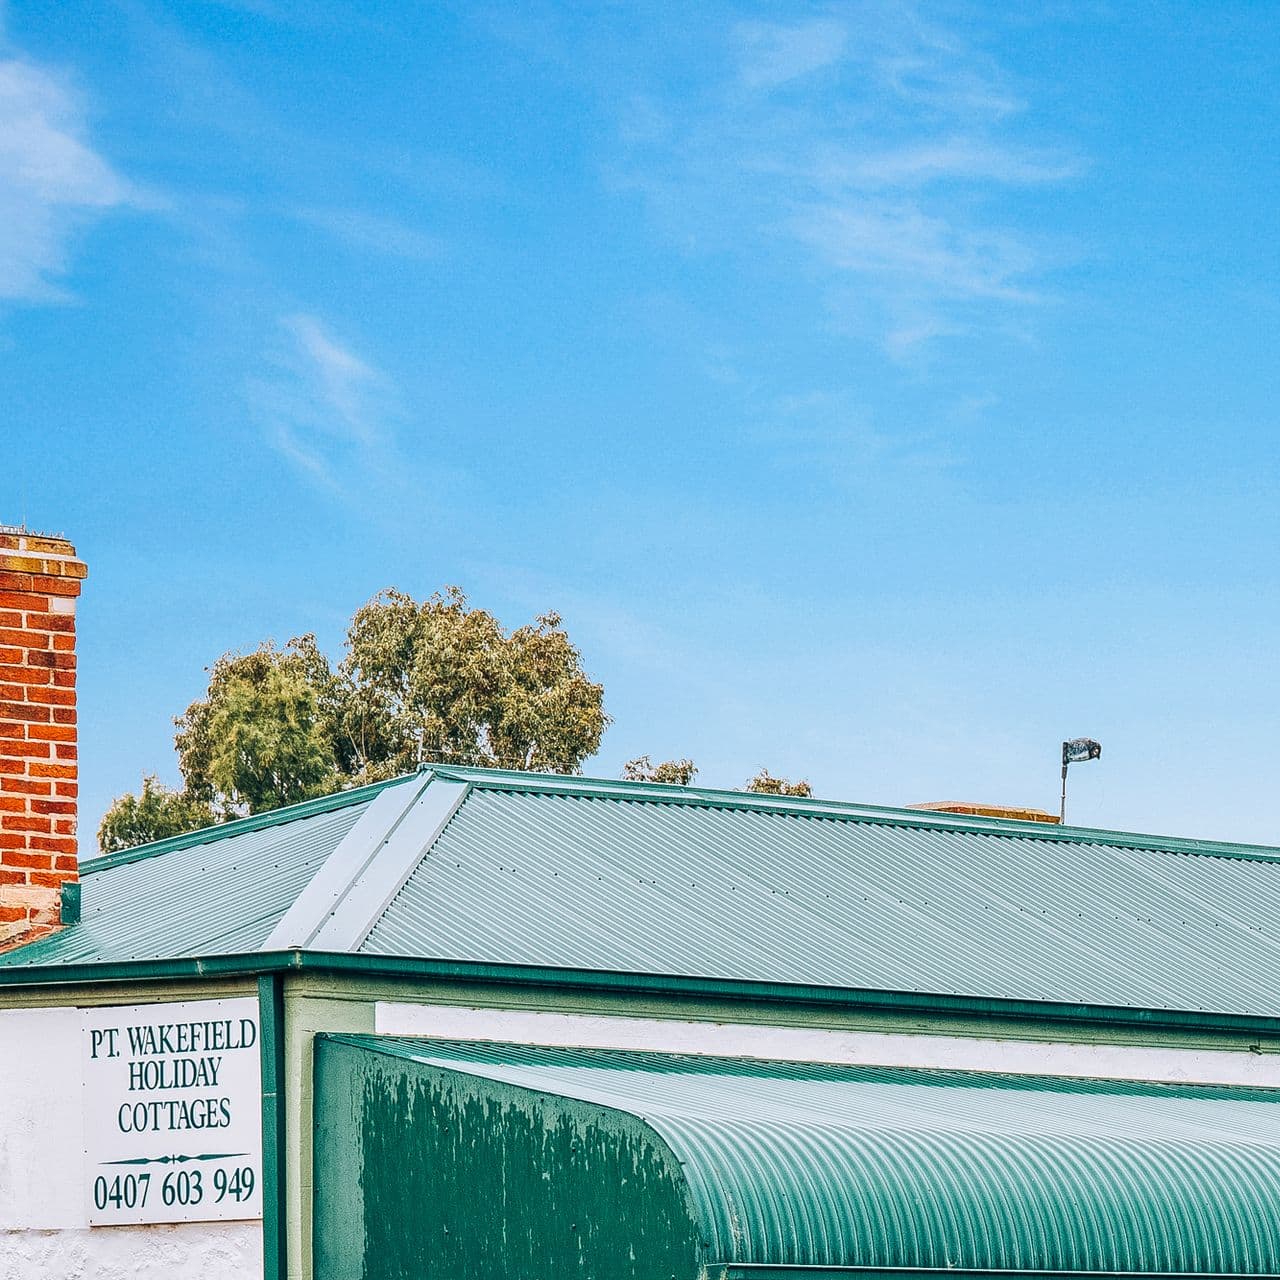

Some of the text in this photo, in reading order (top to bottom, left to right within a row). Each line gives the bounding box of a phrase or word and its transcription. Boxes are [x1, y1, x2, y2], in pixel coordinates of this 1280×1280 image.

[90, 1019, 257, 1059] PT. WAKEFIELD
[128, 1056, 222, 1091] HOLIDAY
[118, 1097, 231, 1133] COTTAGES
[94, 1167, 255, 1210] 0407 603 949
